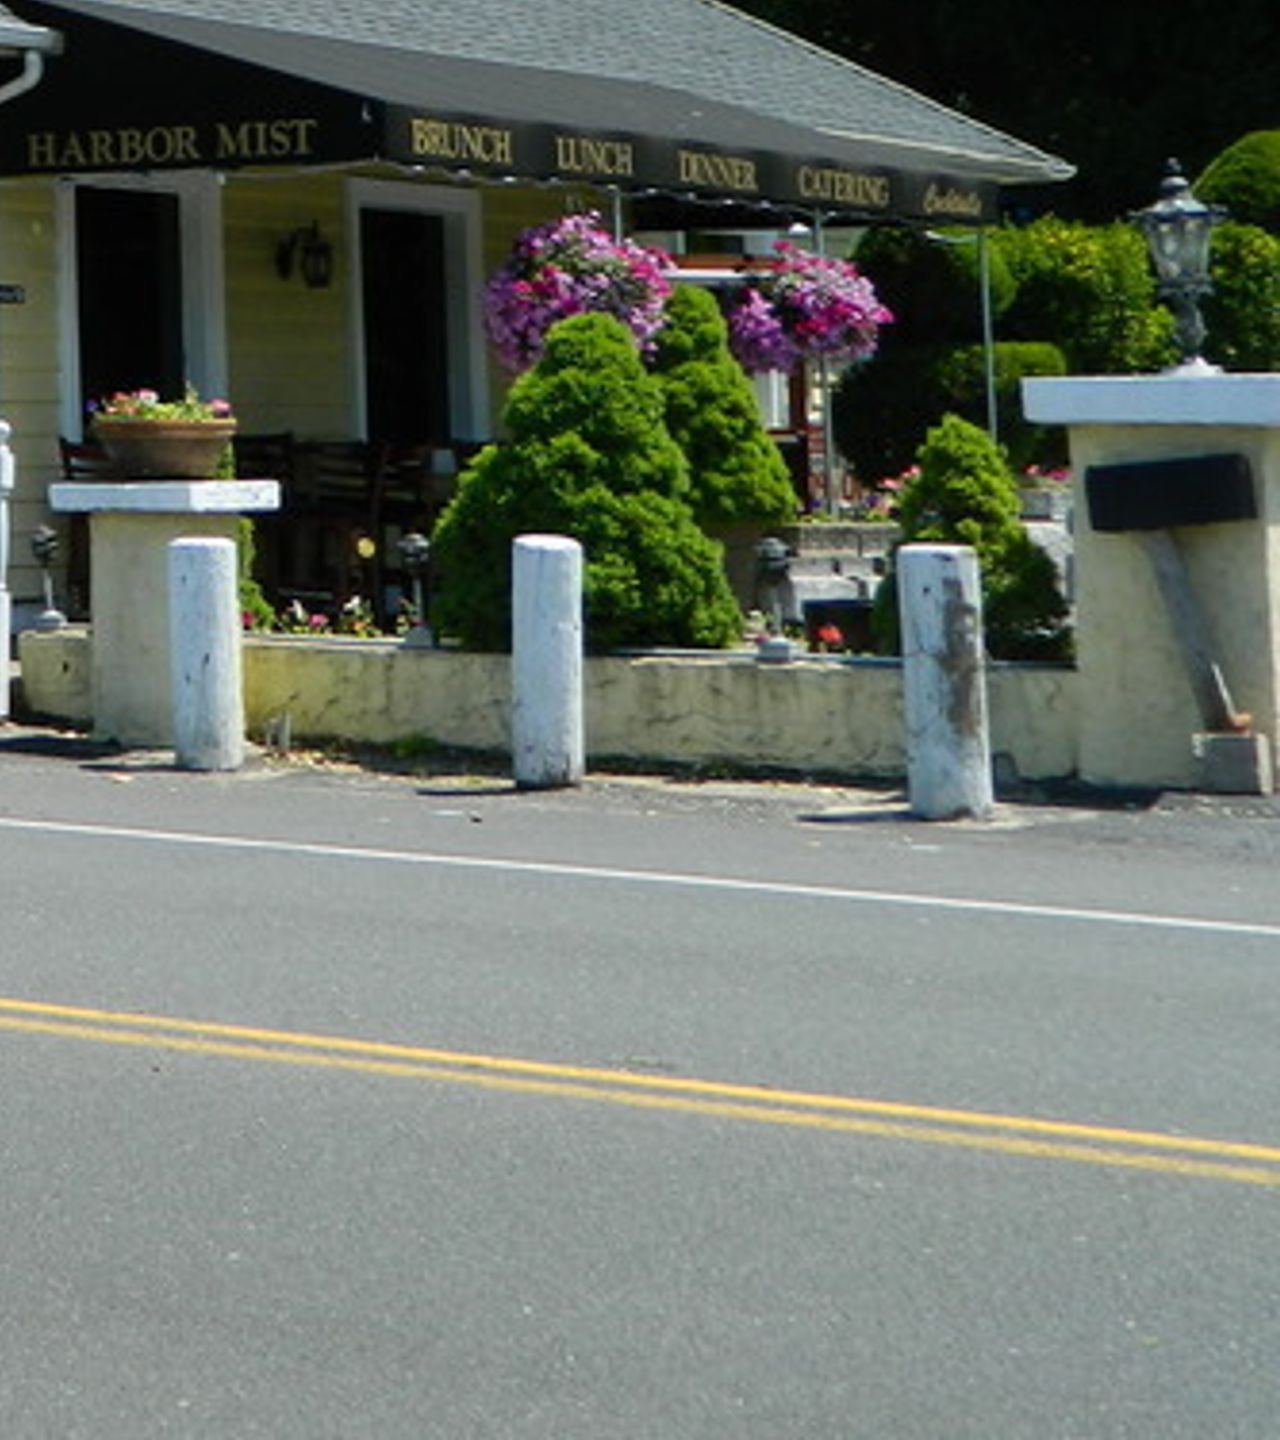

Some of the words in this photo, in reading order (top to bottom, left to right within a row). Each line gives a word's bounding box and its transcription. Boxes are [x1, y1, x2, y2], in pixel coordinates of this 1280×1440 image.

[28, 128, 199, 166] HARBOR
[216, 119, 317, 157] MIST
[411, 119, 513, 163] BRUNCH
[557, 138, 633, 176] LUNCH
[679, 150, 758, 191] DINNER
[798, 167, 890, 206] CATERING
